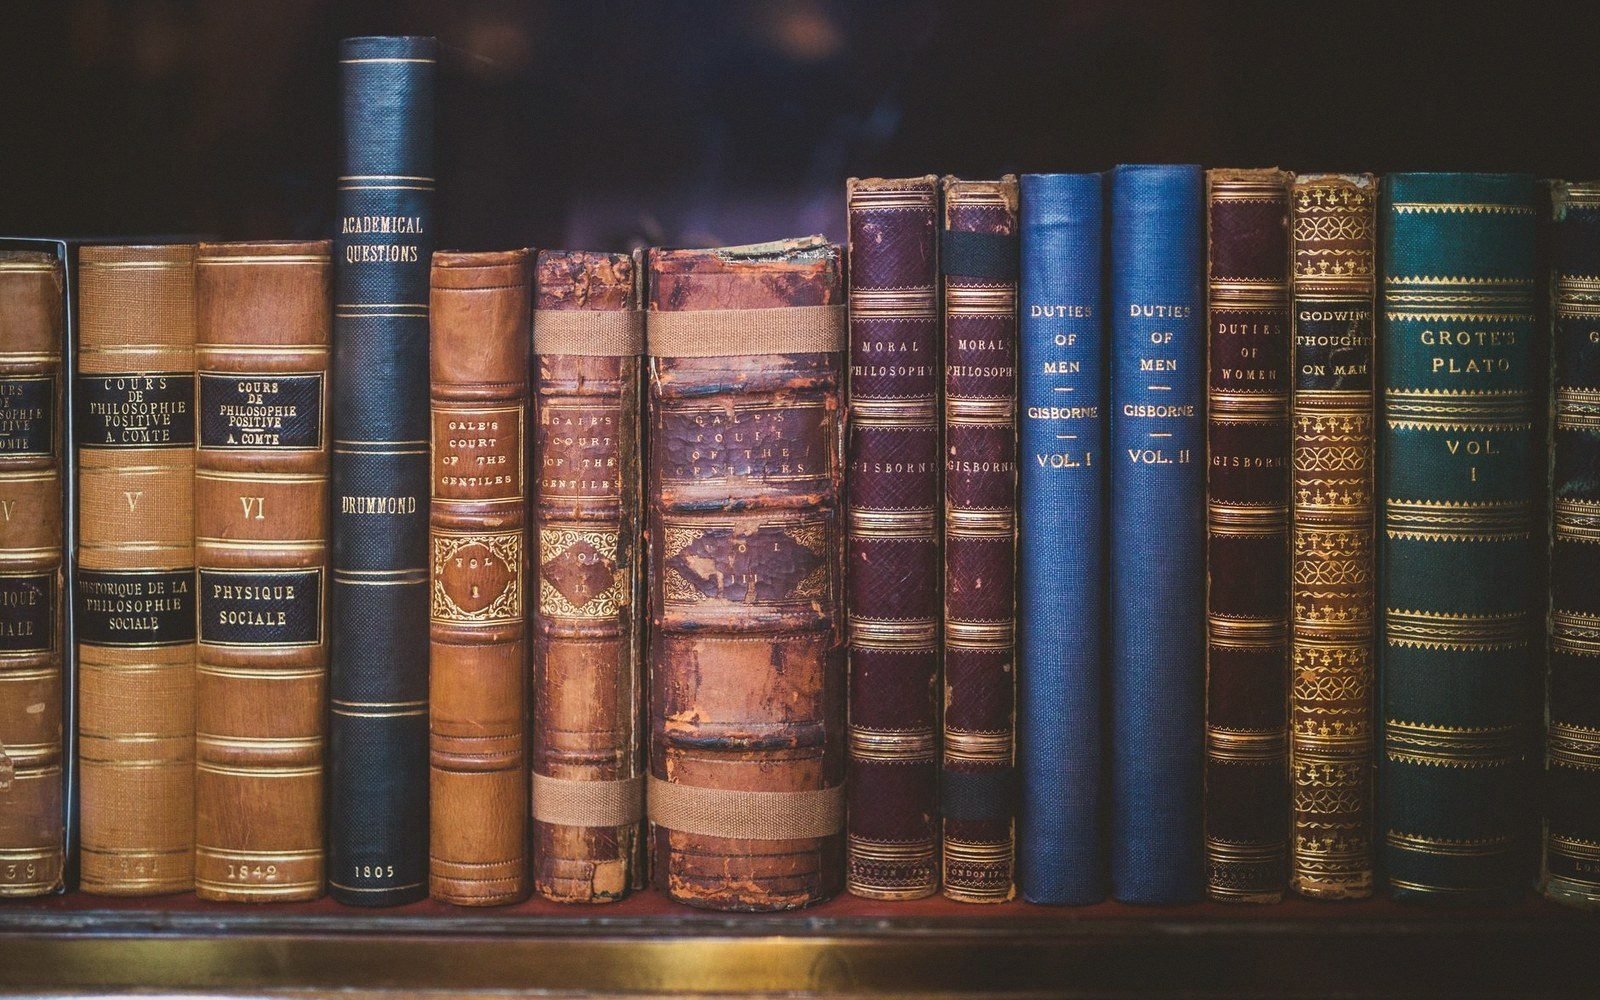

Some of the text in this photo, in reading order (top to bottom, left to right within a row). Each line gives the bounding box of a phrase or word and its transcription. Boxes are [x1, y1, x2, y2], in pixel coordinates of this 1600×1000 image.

[342, 216, 423, 234] ACADEMICAL
[346, 244, 418, 263] QUESTIONS
[1031, 305, 1092, 318] DUTIES
[1130, 304, 1191, 318] DUTIES
[1218, 323, 1281, 335] DUTIES
[958, 339, 1004, 350] MORAL
[1055, 334, 1077, 346] OF
[1151, 332, 1173, 344] OF
[862, 341, 919, 352] MORAL
[1241, 347, 1257, 358] OF
[946, 365, 1013, 377] PHILOSOPH
[1044, 362, 1080, 373] MEN
[1140, 359, 1177, 371] MEN
[1302, 364, 1367, 376] ON MAN
[1432, 358, 1510, 373] PLATO
[1222, 368, 1277, 380] WOMEN
[104, 378, 167, 391] COURS
[238, 382, 279, 394] COURS
[128, 391, 144, 403] DE
[247, 394, 263, 405] DE
[90, 401, 186, 415] PHILOSOPHIE
[220, 404, 297, 417] PHILOSOPHIE
[1028, 406, 1098, 419] GISBORNE
[1124, 404, 1194, 417] GISBORNE
[105, 413, 171, 427] POSITIVE
[228, 415, 281, 428] POSITIVE
[448, 421, 499, 431] GALE'S
[105, 429, 171, 443] A. COMTE
[226, 432, 280, 445] A. COMTE
[552, 437, 611, 446] COURT
[449, 438, 497, 448] COURT
[1446, 440, 1500, 454] VOL.
[442, 455, 506, 466] OF THE
[692, 448, 790, 460] OF THE
[1037, 452, 1092, 468] VOL. I
[1128, 449, 1190, 464] VOL. II
[547, 457, 615, 467] OF THE
[1213, 456, 1288, 468] GISBORN
[441, 475, 512, 487] GENTILES
[1470, 467, 1476, 482] I
[542, 480, 621, 489] GENTILES
[124, 491, 143, 512] V
[240, 497, 266, 519] VI
[342, 496, 416, 514] DRUMMOND
[455, 558, 493, 569] VOL
[564, 552, 600, 563] VOL
[79, 580, 188, 598] HISTORIQUE DE LA
[213, 584, 295, 600] PHYSIQUE
[574, 584, 588, 593] II
[87, 598, 182, 613] PHILOSOPHIE
[109, 616, 159, 631] SOCIALE
[219, 610, 287, 626] SOCIALE
[227, 864, 279, 880] 1842
[354, 865, 394, 879] 1805
[947, 868, 986, 879] ONDON
